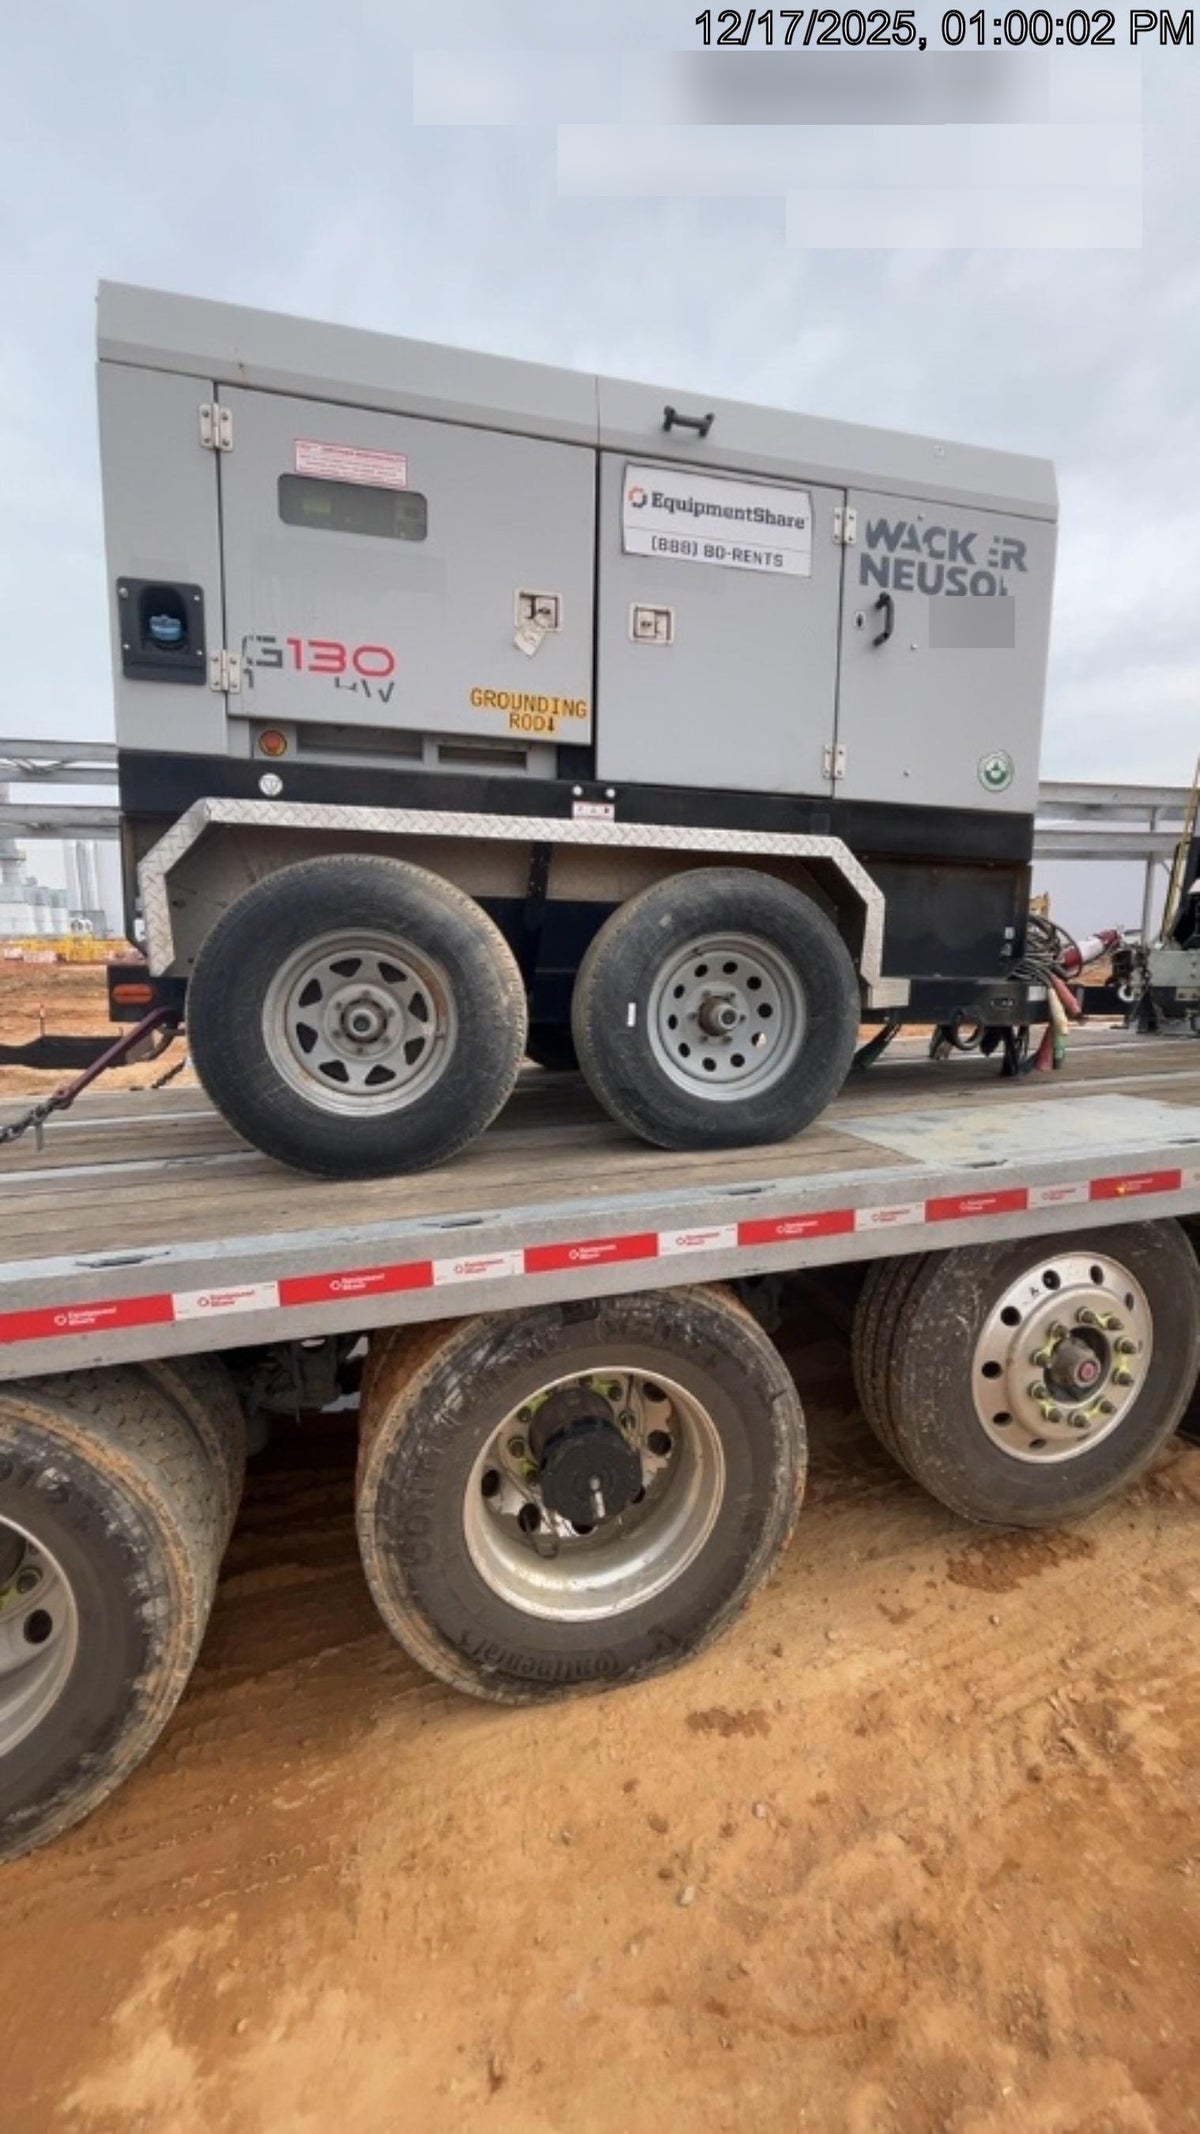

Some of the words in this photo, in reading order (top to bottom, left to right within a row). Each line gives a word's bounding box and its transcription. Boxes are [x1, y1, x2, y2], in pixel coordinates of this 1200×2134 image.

[651, 491, 806, 529] EquipmentShare
[651, 536, 698, 557] (888)
[704, 543, 783, 568] 80-RENTS
[860, 552, 1009, 596] NEUSO
[241, 634, 395, 678] G130
[470, 687, 587, 718] GROUNDING
[509, 712, 546, 731] ROD
